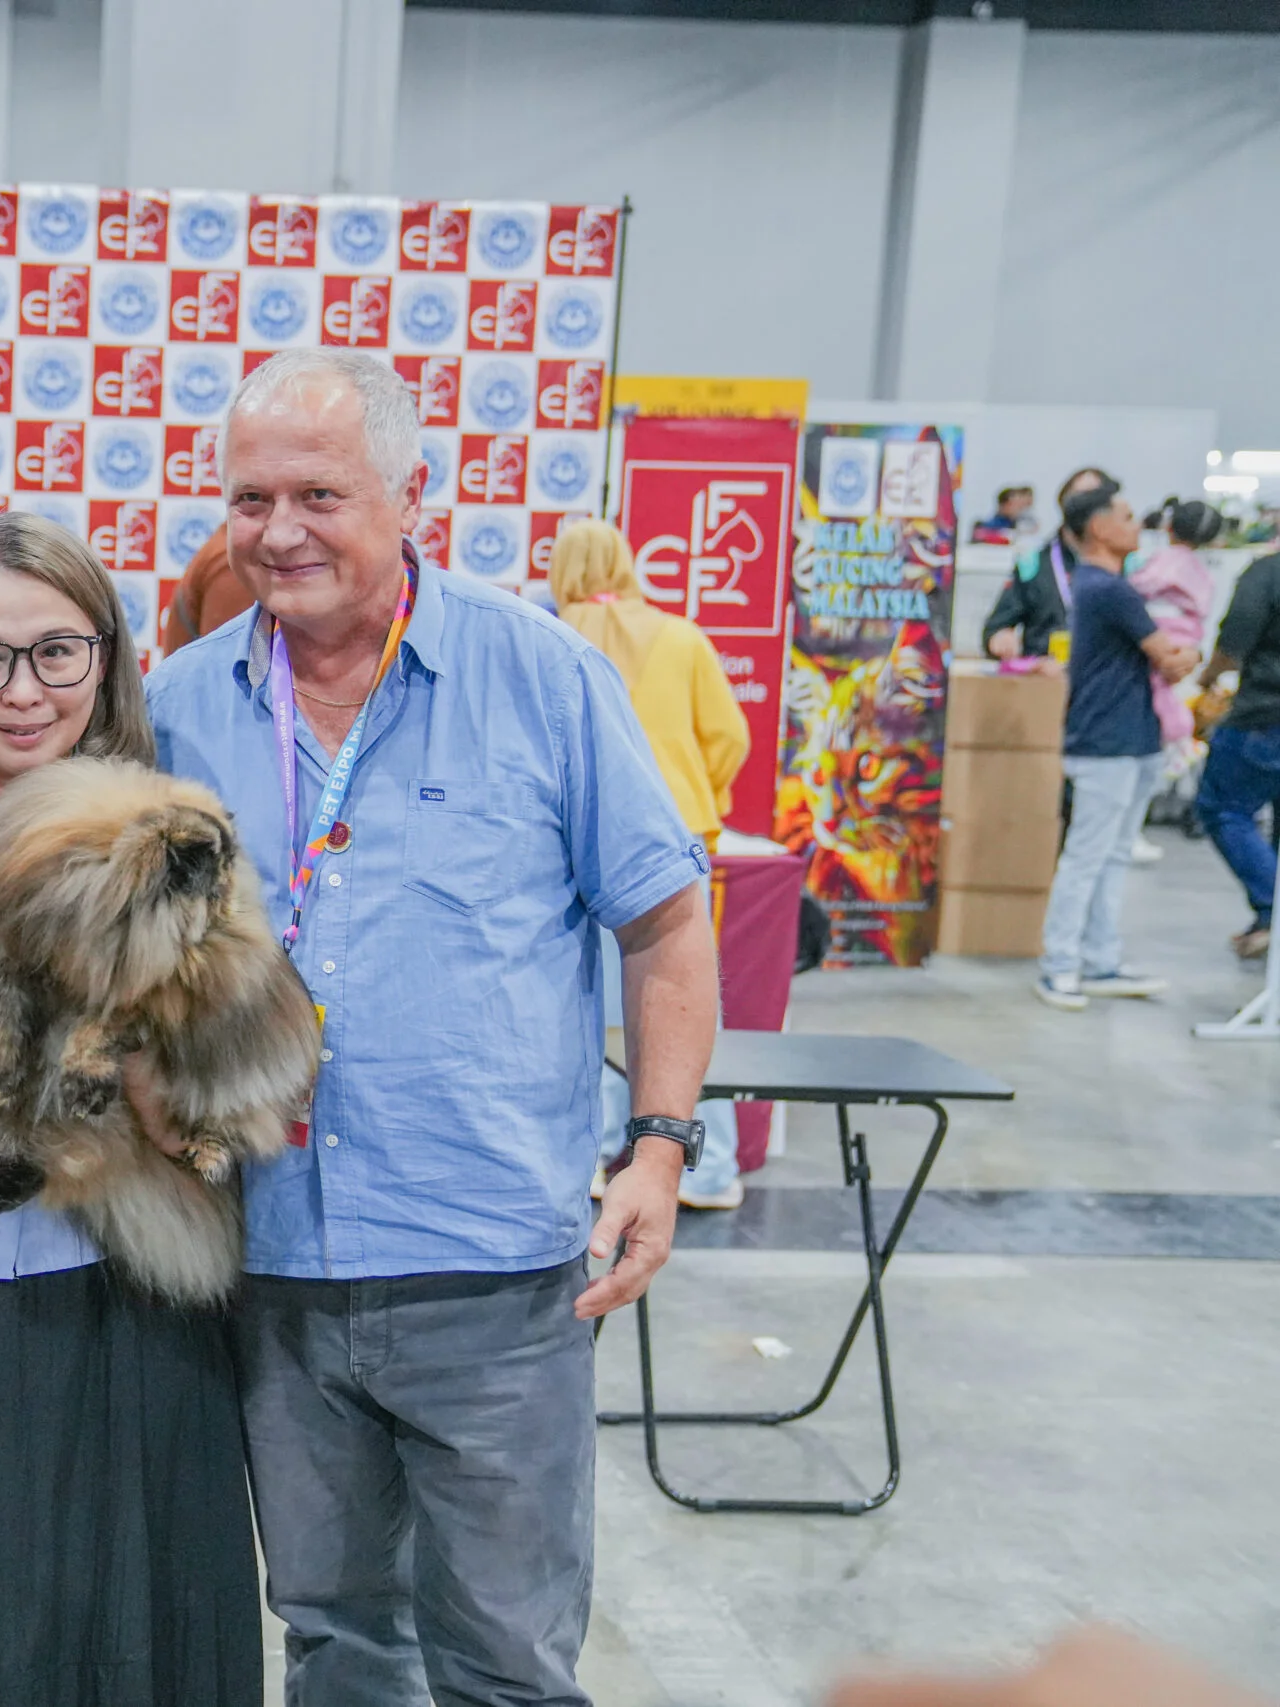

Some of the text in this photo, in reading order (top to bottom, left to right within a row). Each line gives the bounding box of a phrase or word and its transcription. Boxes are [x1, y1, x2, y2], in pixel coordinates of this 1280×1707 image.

[813, 522, 895, 553] KELAB
[812, 555, 905, 586] KUCING
[809, 586, 930, 619] MALAYSIA
[318, 795, 339, 827] PET
[331, 746, 355, 792] EXPO
